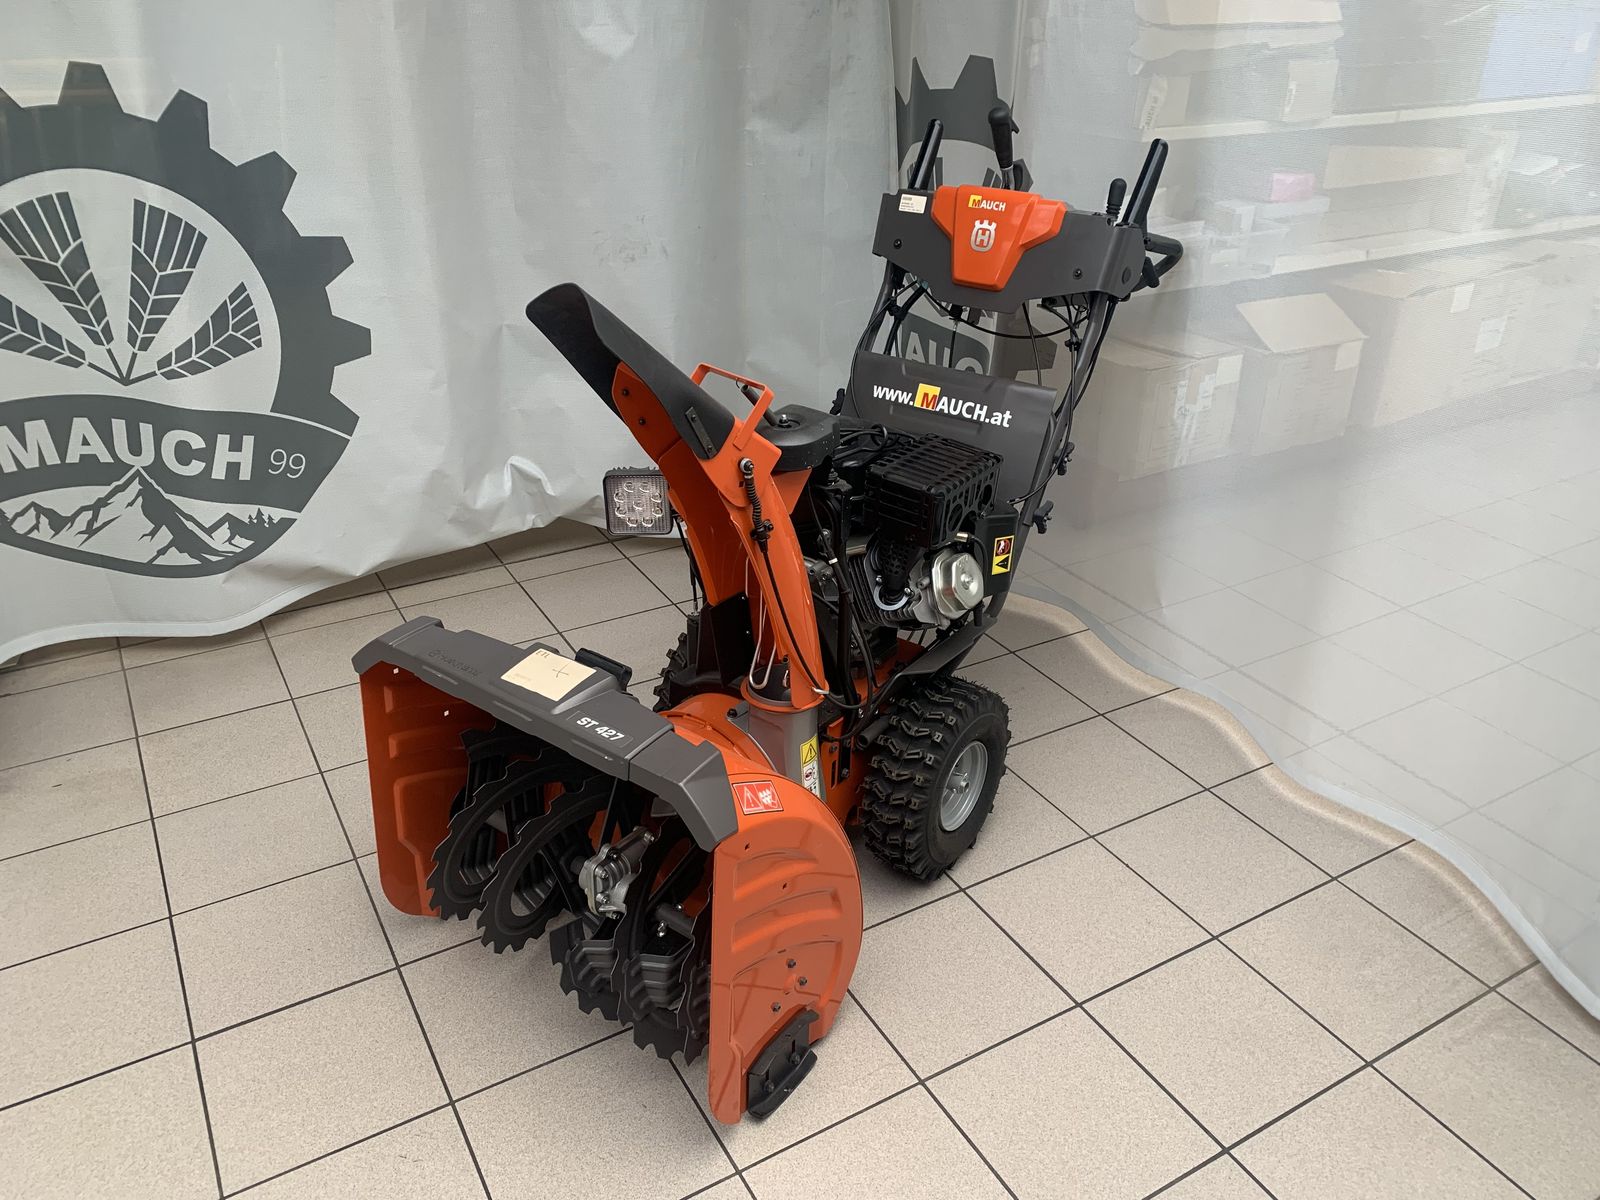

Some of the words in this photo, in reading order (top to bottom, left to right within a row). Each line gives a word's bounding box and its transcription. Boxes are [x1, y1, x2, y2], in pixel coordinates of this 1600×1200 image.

[971, 198, 1006, 212] MAUCH
[873, 384, 1012, 428] www.MAUCH.at
[0, 417, 255, 481] MAUCH
[268, 448, 306, 479] 99
[576, 717, 599, 728] ST
[594, 726, 625, 740] 427
